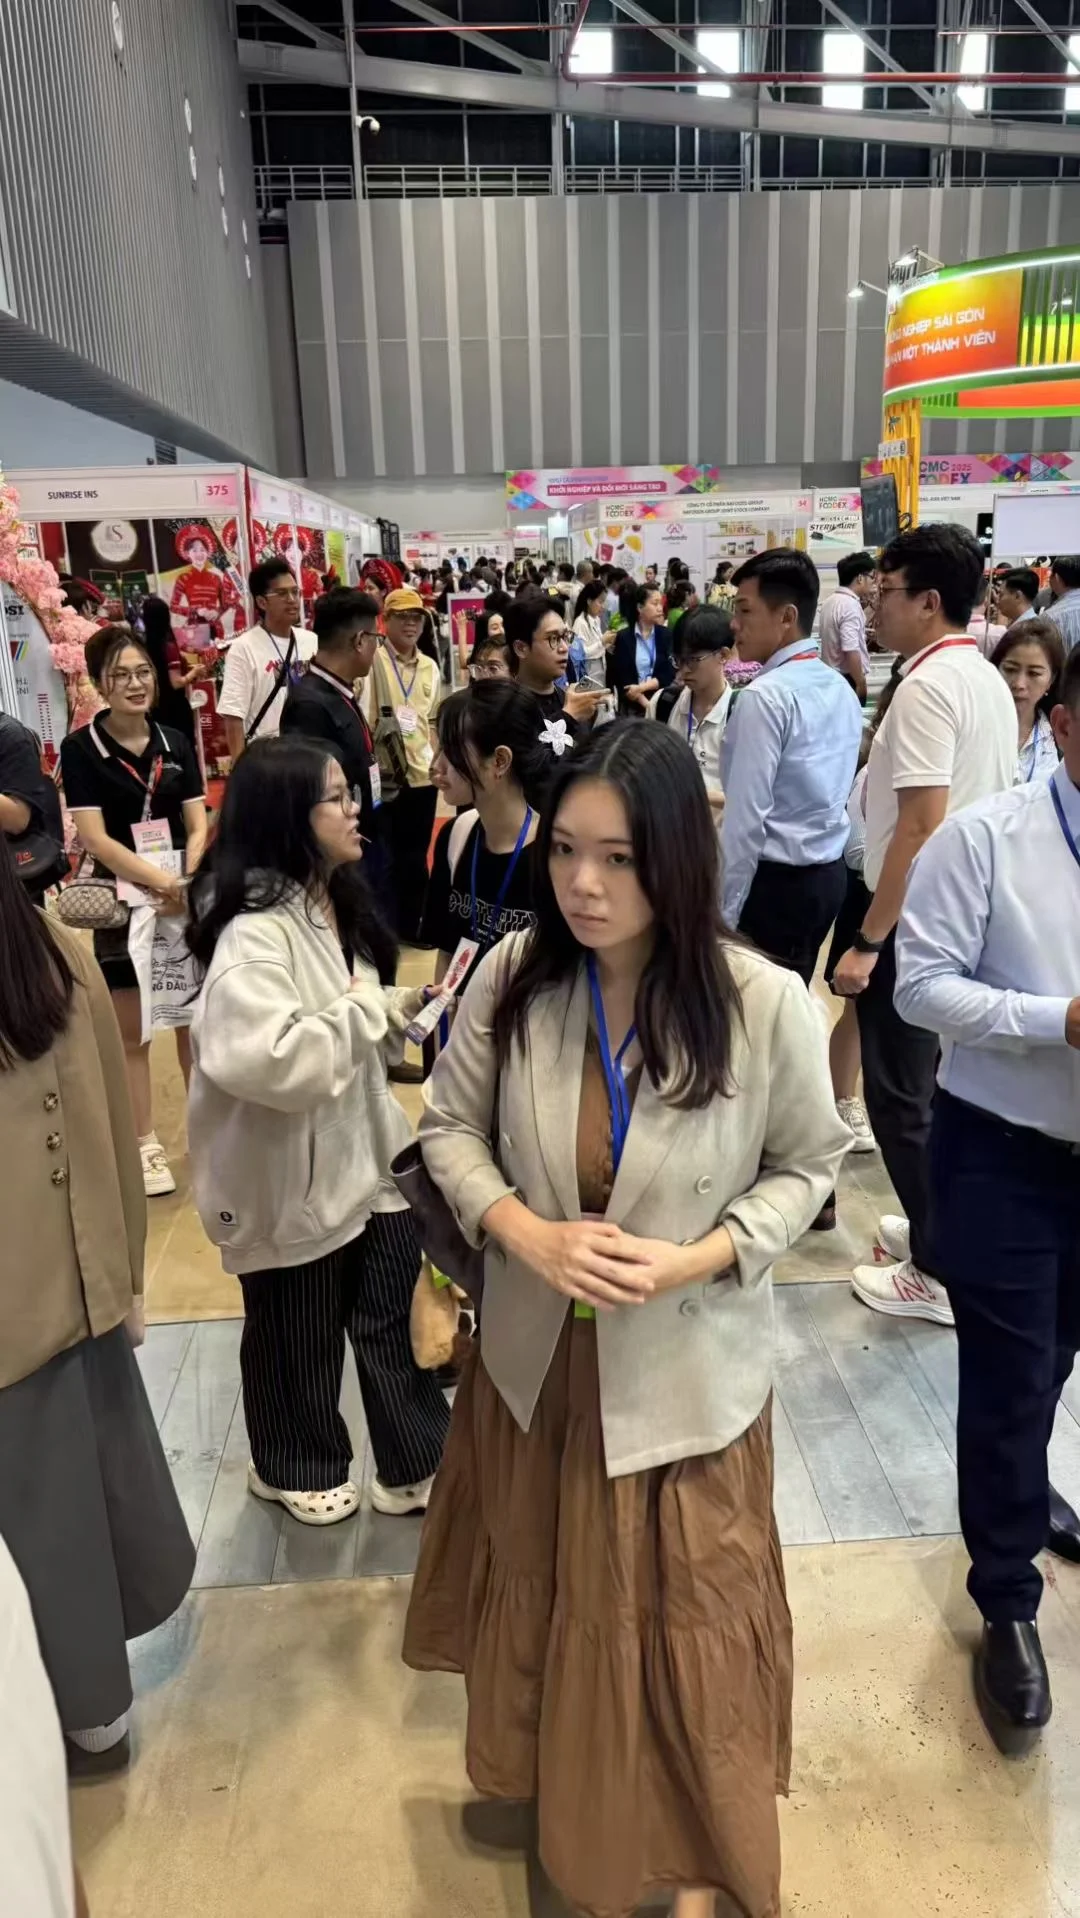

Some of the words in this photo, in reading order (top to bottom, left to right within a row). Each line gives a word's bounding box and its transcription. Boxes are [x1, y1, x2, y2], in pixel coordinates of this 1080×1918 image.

[934, 312, 953, 328] SÀI
[956, 307, 985, 324] GÒN
[921, 335, 960, 356] THÀNH
[964, 329, 996, 348] VIÊN
[919, 461, 950, 472] CMC
[206, 485, 229, 496] 375
[567, 485, 591, 493] NGHIỆP
[48, 491, 82, 500] SUNRISE
[84, 490, 98, 499] INS
